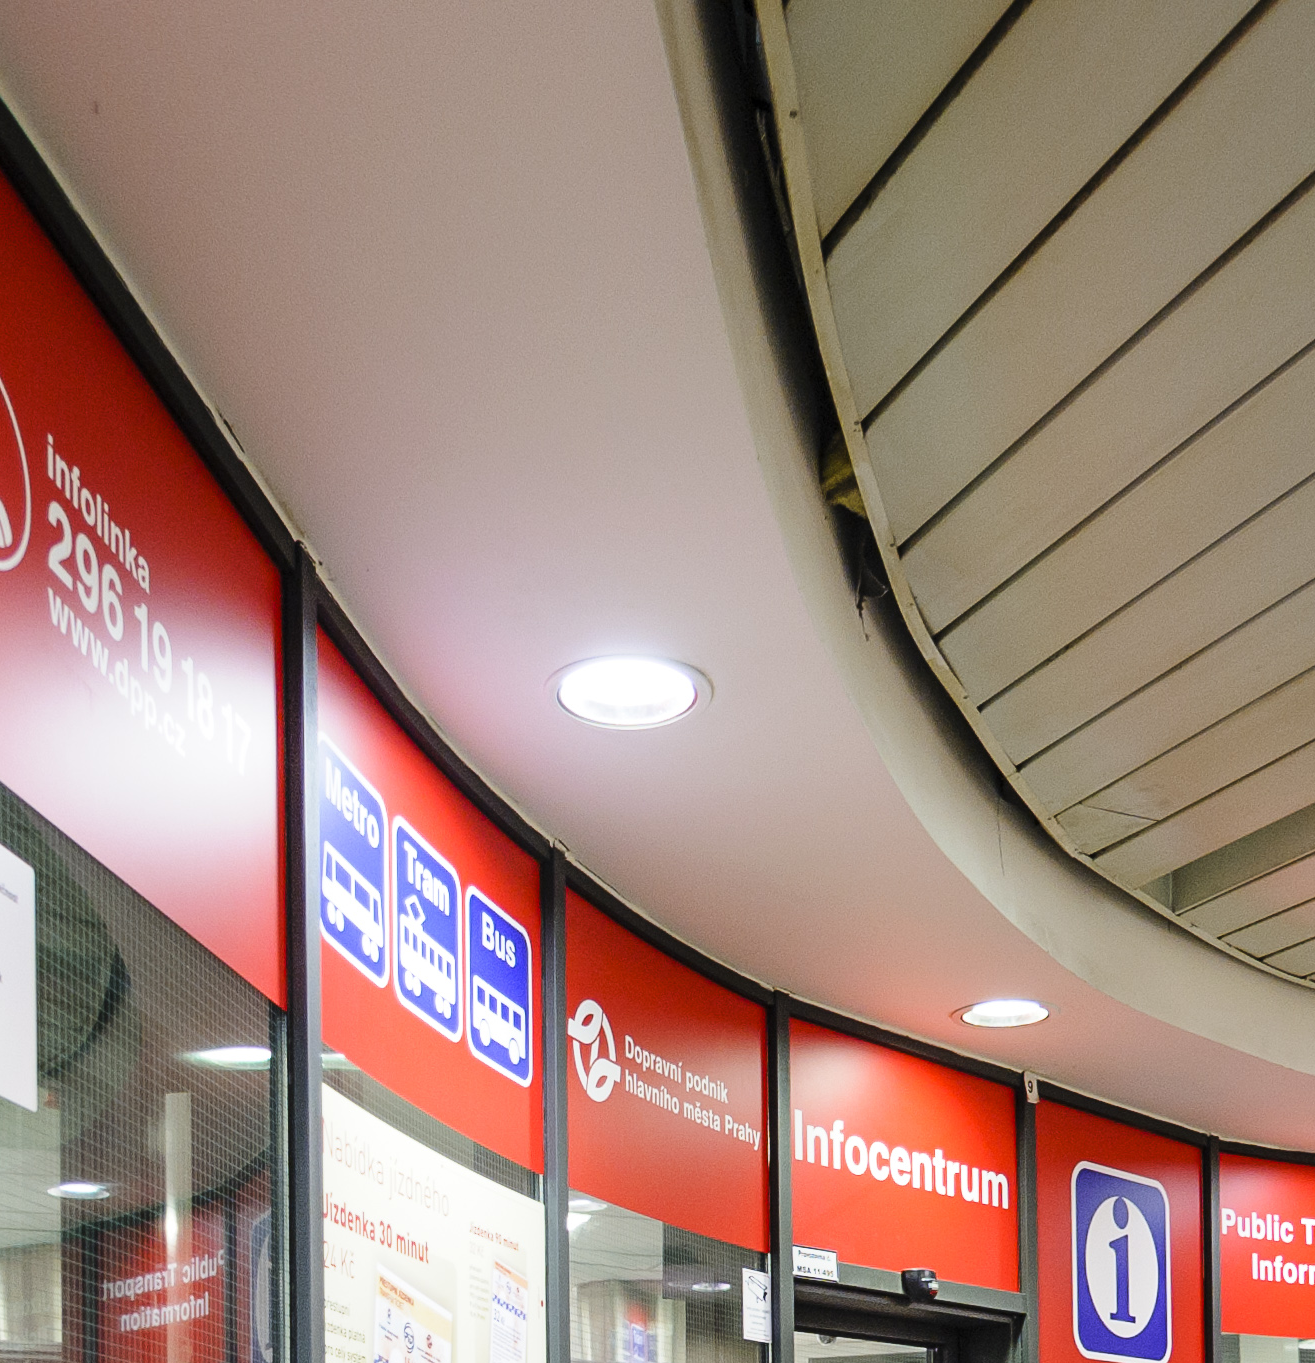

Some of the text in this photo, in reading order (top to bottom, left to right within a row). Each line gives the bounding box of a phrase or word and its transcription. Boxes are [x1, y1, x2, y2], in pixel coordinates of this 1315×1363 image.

[47, 433, 151, 595] infolinka
[48, 501, 251, 777] 296 19 18 17
[48, 587, 186, 758] www.dpp.cz
[325, 757, 379, 849] Metro
[404, 841, 450, 917] Tram
[481, 911, 516, 968] Bus
[625, 1034, 729, 1104] Dopravní podnik
[625, 1070, 761, 1151] hlavního města Prahy
[322, 1116, 384, 1186] Nabídka
[794, 1108, 1009, 1209] Infocentrum
[322, 1193, 429, 1264] Jízdenka 30 minut
[1221, 1208, 1294, 1244] Public
